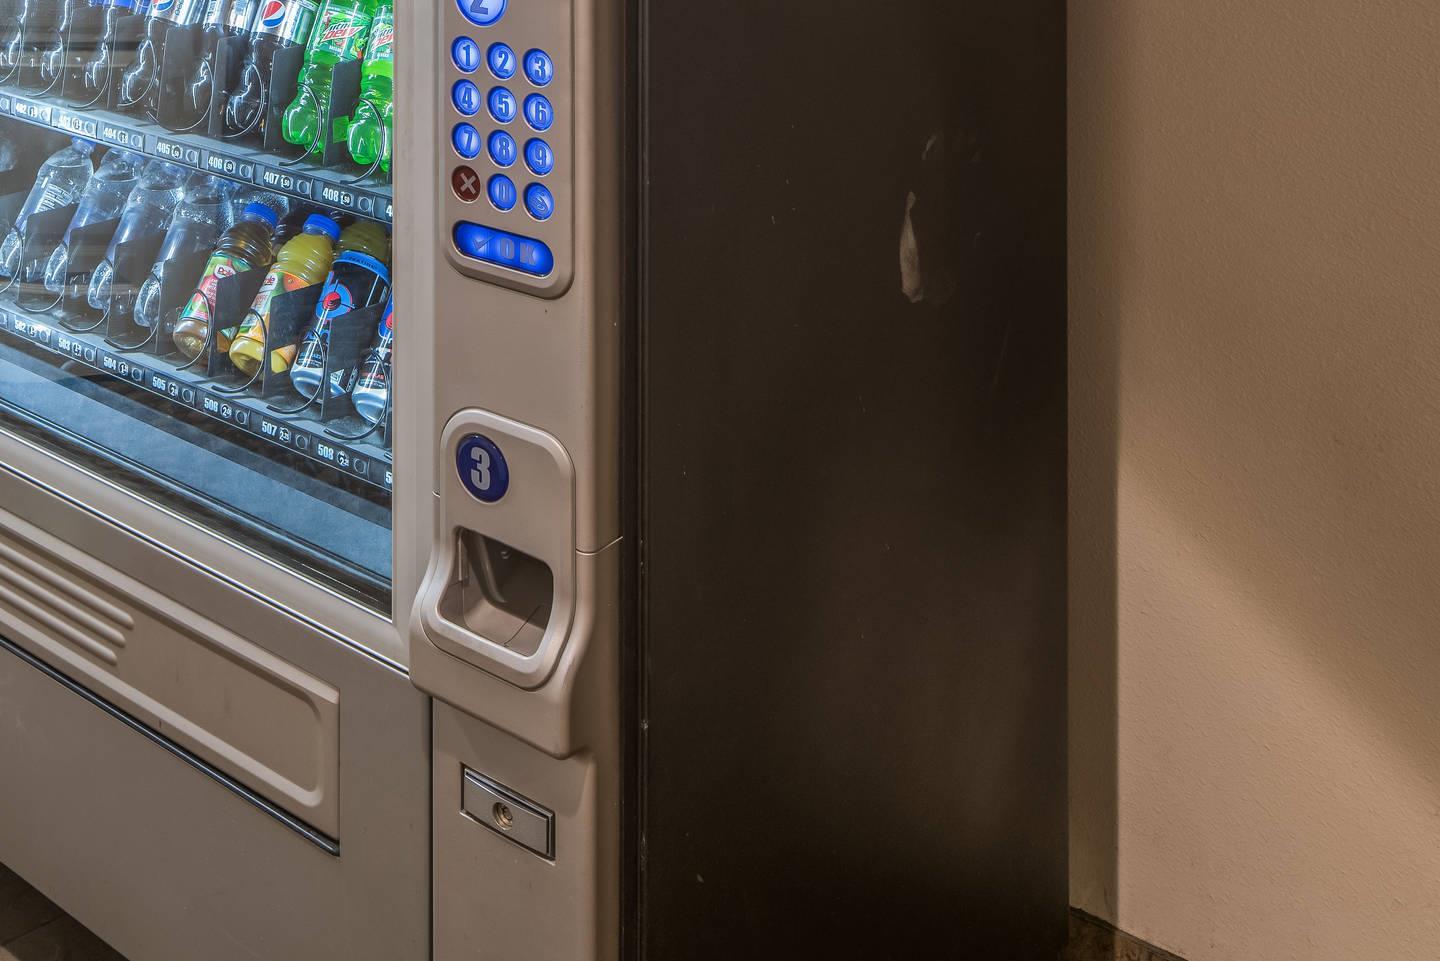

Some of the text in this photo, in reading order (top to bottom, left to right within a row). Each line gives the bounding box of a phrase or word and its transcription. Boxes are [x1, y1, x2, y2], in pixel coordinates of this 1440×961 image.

[462, 44, 546, 80] 1 2 3
[462, 86, 546, 124] 4 5 6
[104, 127, 116, 140] 404
[156, 142, 170, 154] 405
[464, 130, 547, 168] 7 8 9
[208, 156, 222, 169] 406
[264, 171, 280, 185] 407
[322, 187, 339, 202] 408
[498, 182, 510, 202] 0
[500, 237, 536, 266] OK
[14, 319, 26, 333] 502
[58, 337, 70, 351] 503
[103, 356, 116, 371] 504
[152, 376, 166, 391] 505
[204, 397, 218, 413] 506
[262, 420, 278, 436] 507
[318, 442, 334, 460] 508
[470, 446, 491, 490] 3
